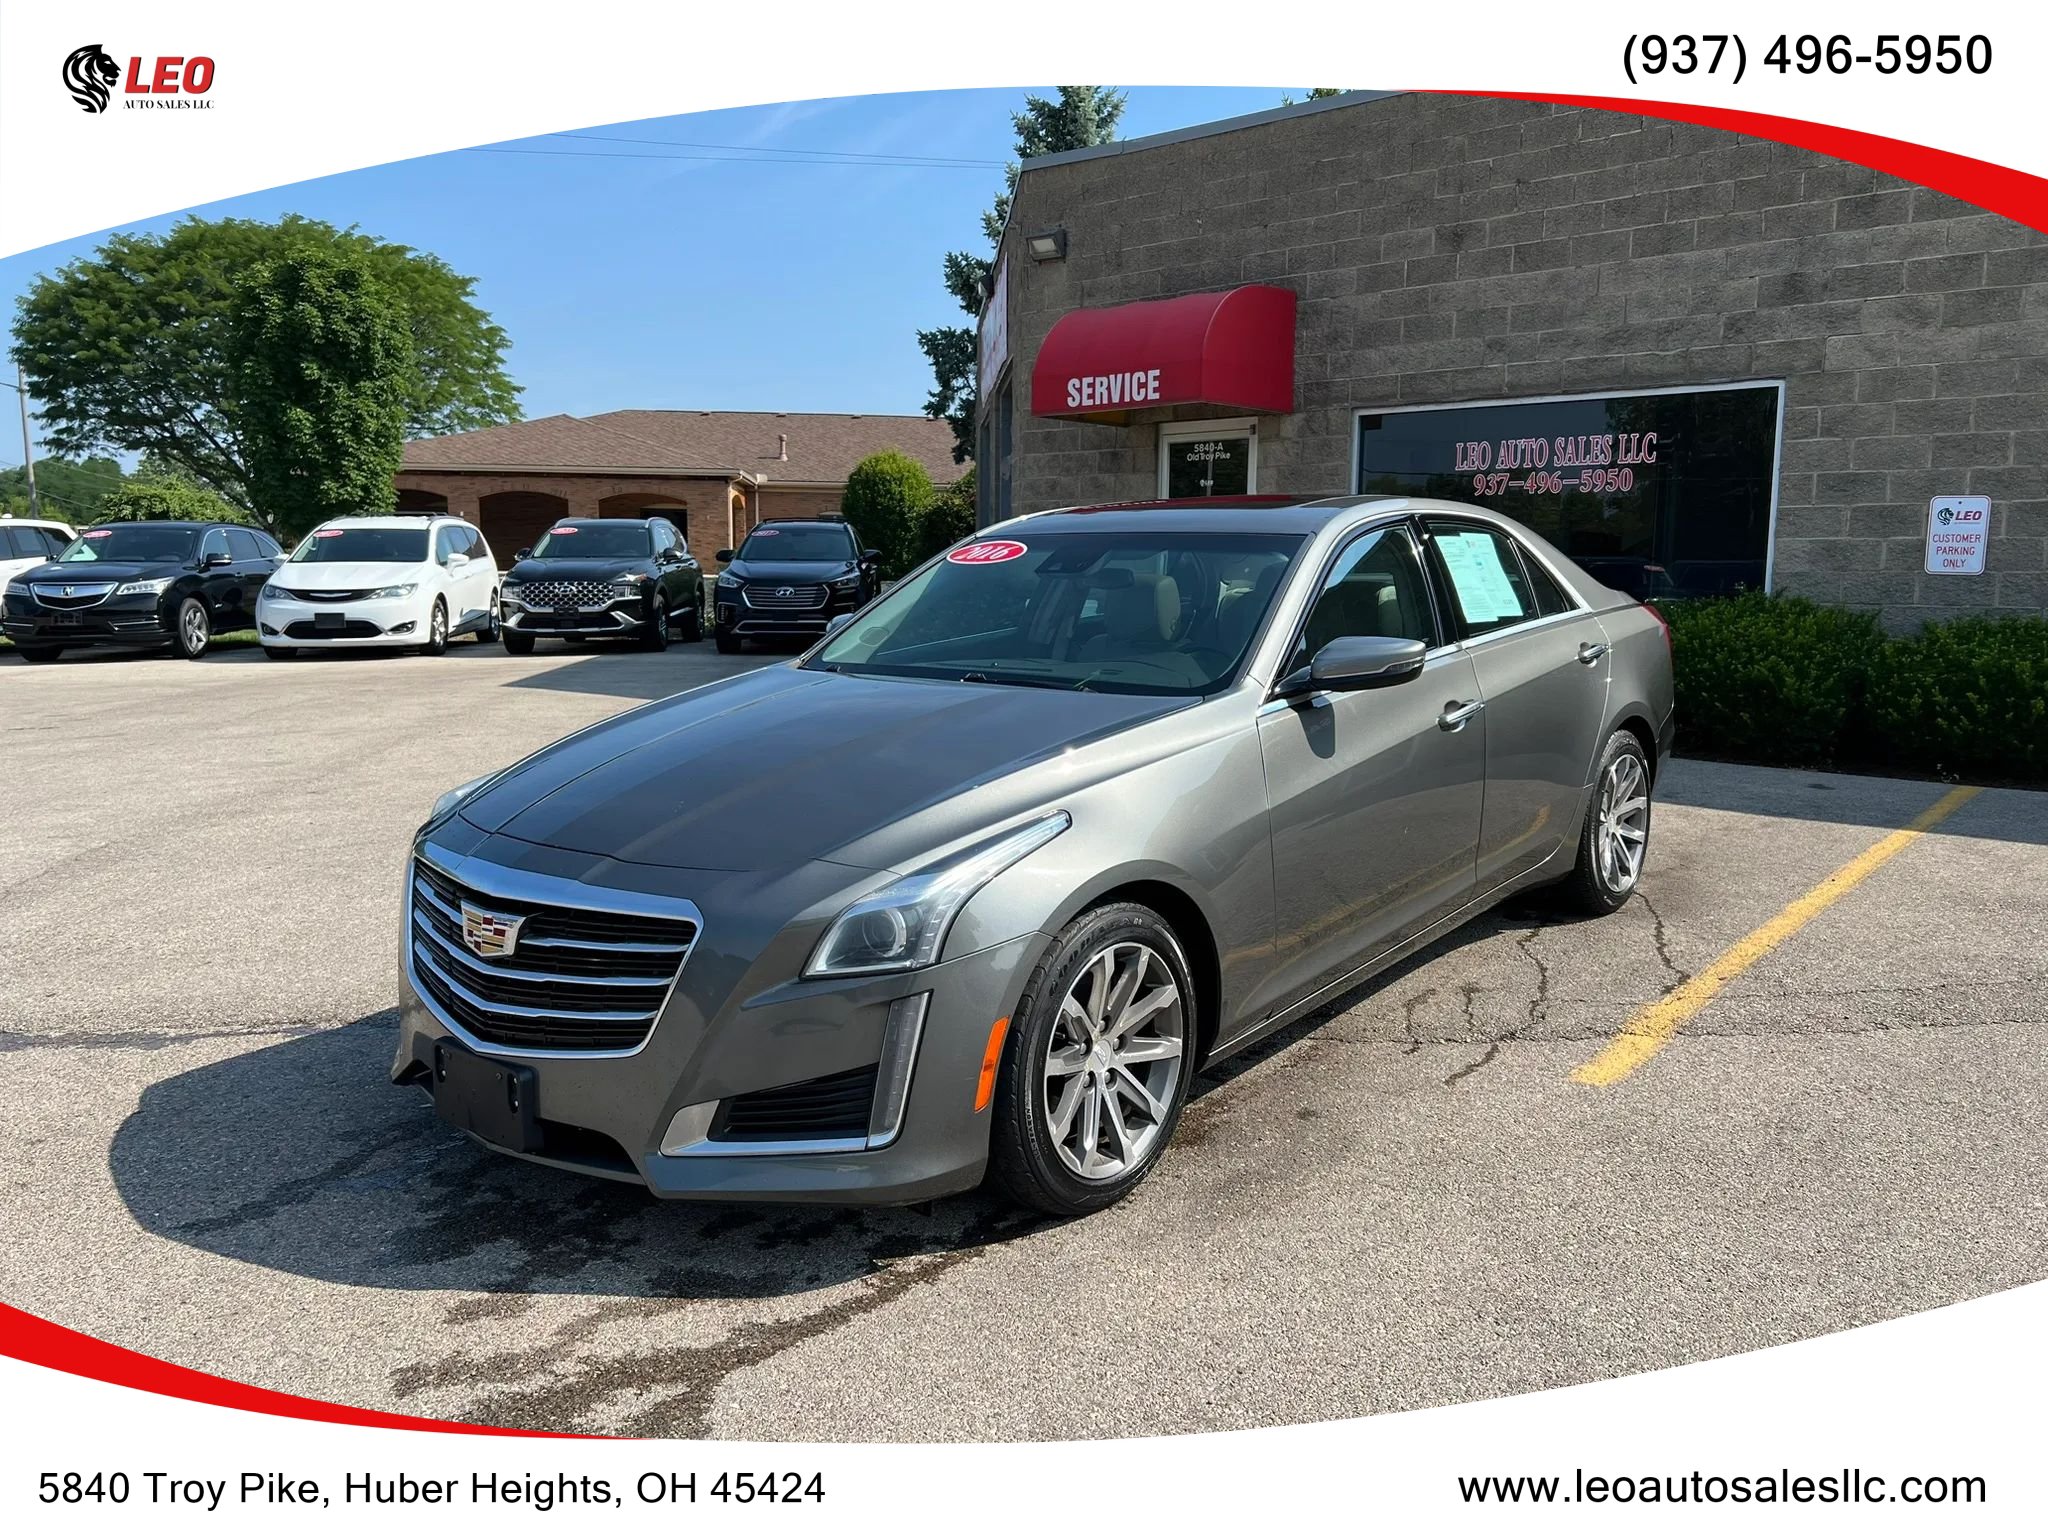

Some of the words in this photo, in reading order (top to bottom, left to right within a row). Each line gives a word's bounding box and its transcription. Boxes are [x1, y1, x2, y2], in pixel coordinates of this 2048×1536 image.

[1067, 369, 1160, 408] SERVICE
[1194, 442, 1224, 453] 5840-A
[1455, 441, 1492, 471] LEO
[1496, 438, 1549, 469] AUTO
[1554, 434, 1613, 467] SALES
[1618, 432, 1657, 465] LLC
[1186, 452, 1200, 462] Old
[1200, 451, 1215, 462] Troy
[1215, 451, 1231, 460] Pike
[1473, 467, 1634, 496] 937-496-5950
[1955, 510, 1983, 521] LEO
[1932, 533, 1982, 543] CUSTOMER
[952, 545, 1021, 560] 2016
[1936, 546, 1976, 556] PARKING
[1942, 558, 1967, 568] ONLY
